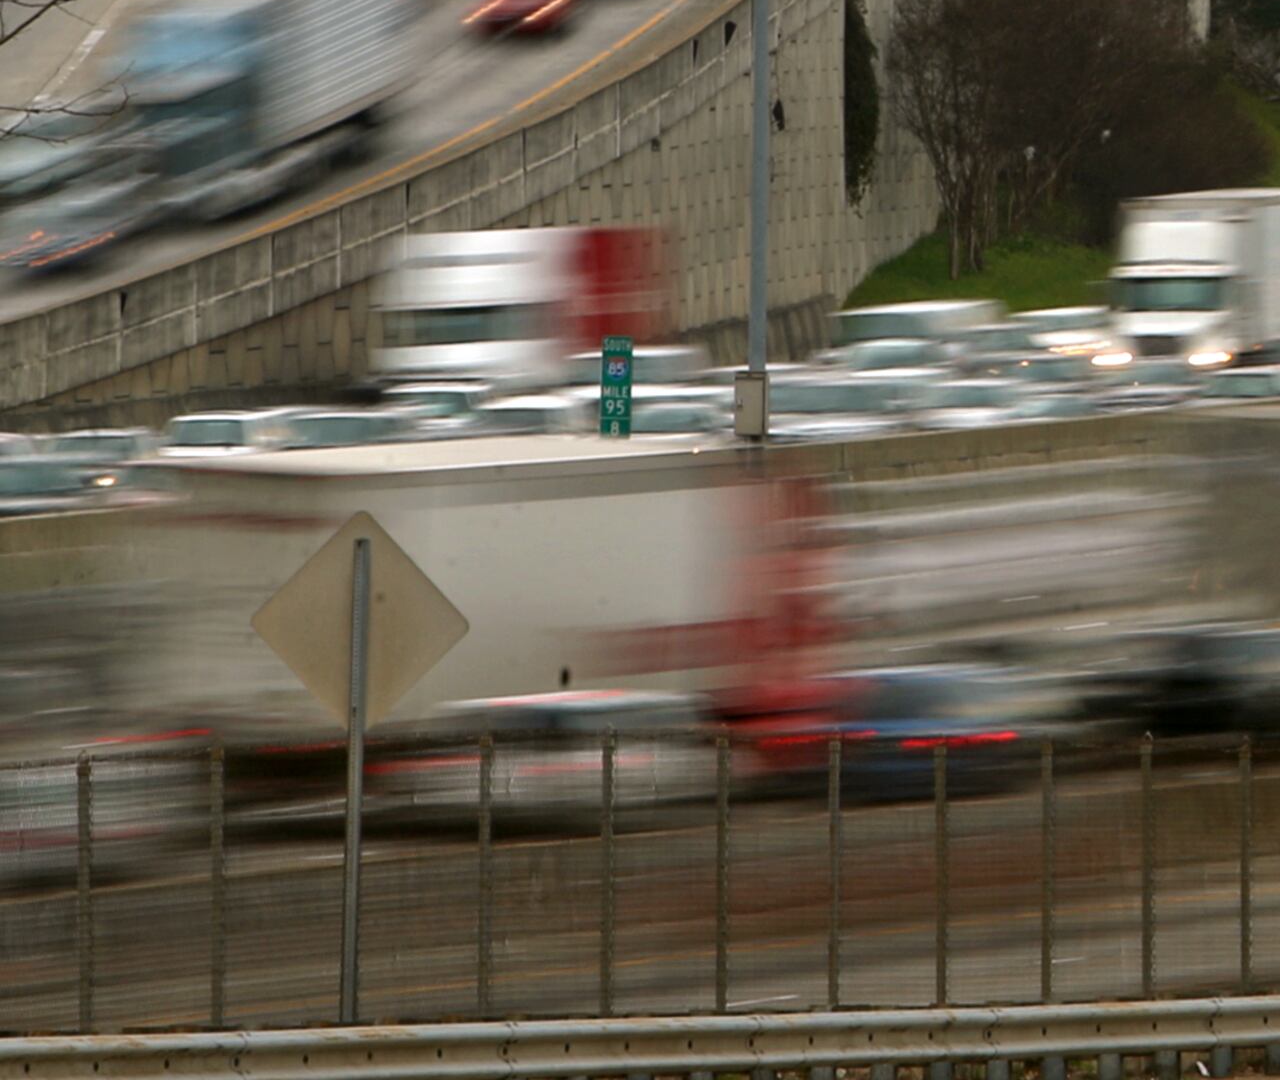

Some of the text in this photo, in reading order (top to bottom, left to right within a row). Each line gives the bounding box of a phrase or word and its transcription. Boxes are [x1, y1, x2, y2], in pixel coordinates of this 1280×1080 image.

[604, 338, 632, 351] SOUTH
[608, 362, 625, 375] 85
[603, 385, 629, 398] MILE
[606, 400, 625, 415] 95
[610, 421, 620, 437] 8
